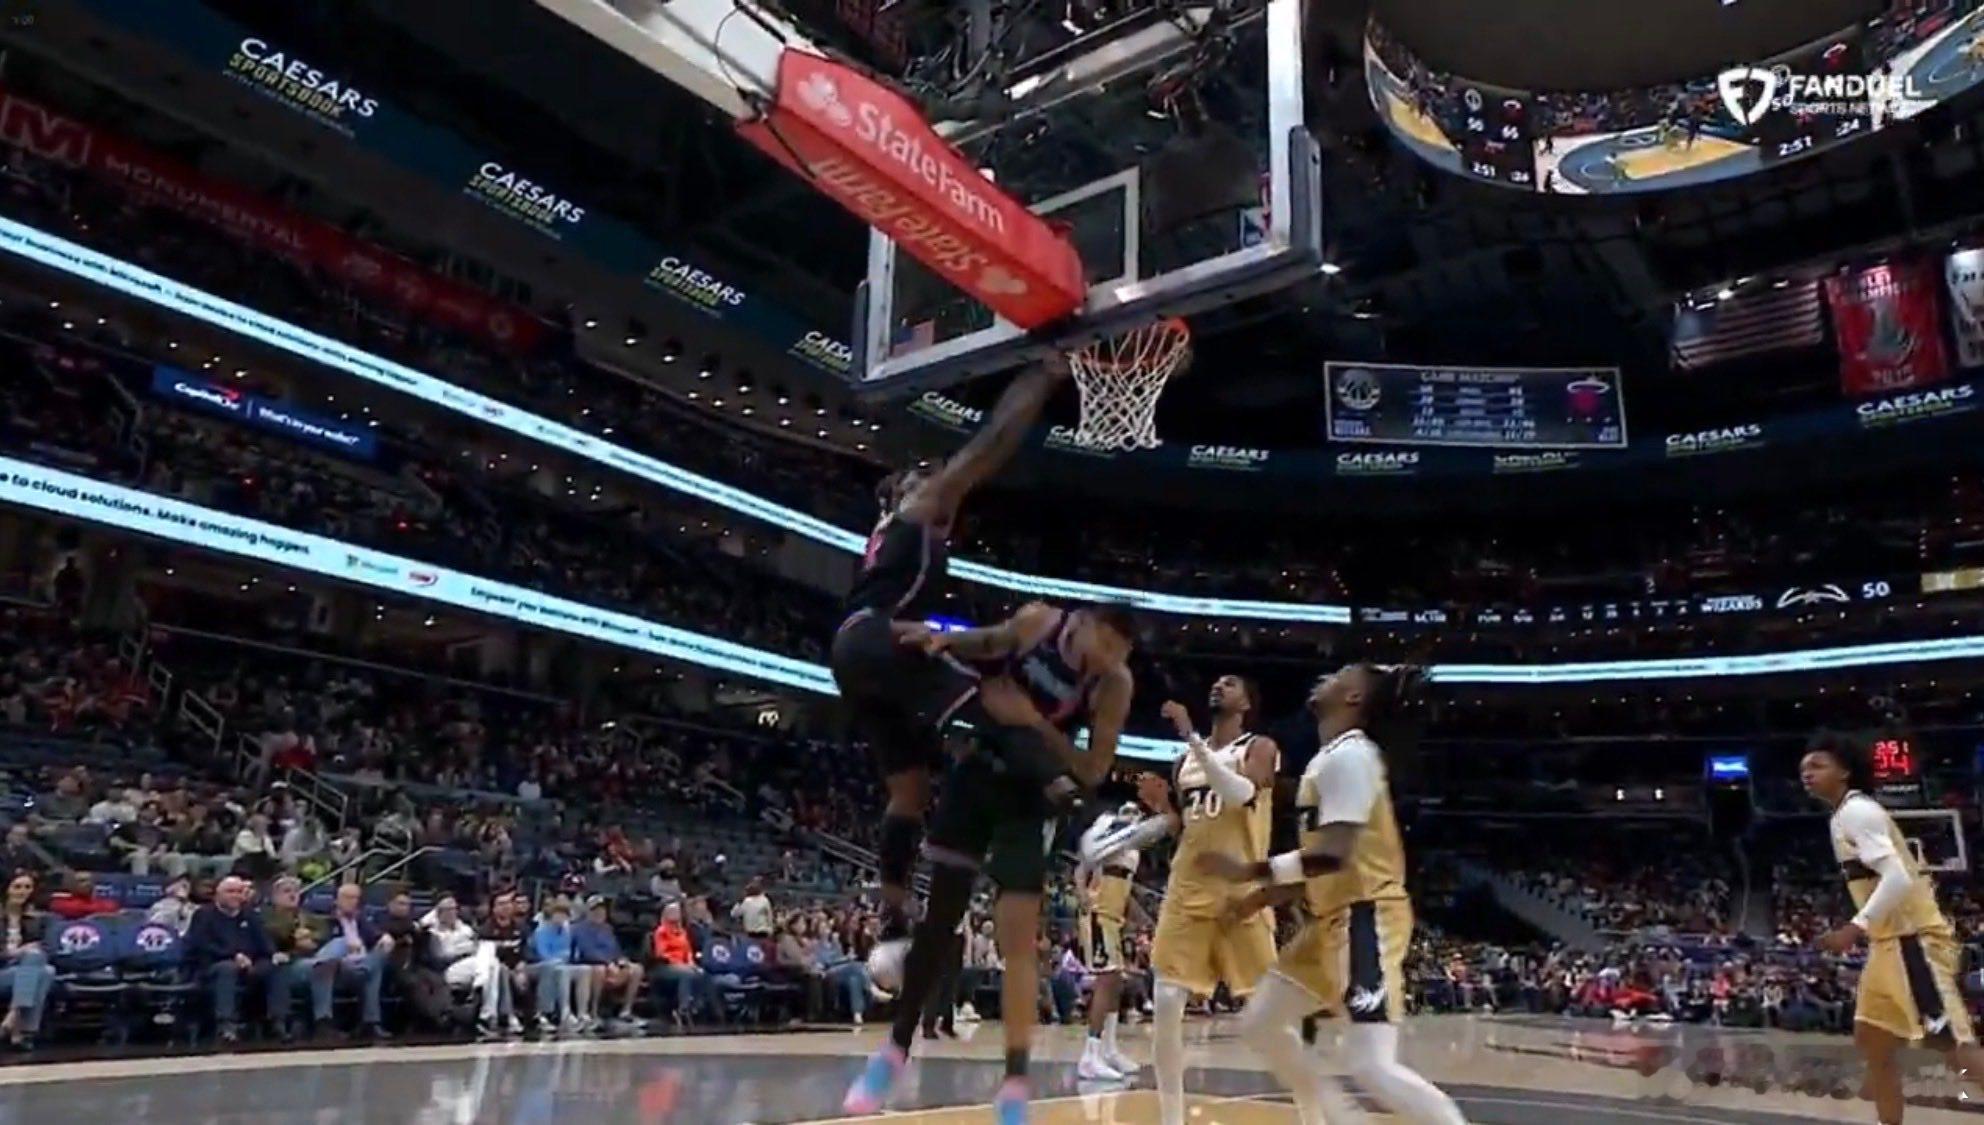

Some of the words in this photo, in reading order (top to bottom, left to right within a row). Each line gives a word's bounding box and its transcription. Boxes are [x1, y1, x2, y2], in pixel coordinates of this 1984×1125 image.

[228, 52, 346, 119] SPORTSBOOK
[239, 37, 379, 118] CAESARS
[479, 161, 586, 223] CAESARS
[855, 101, 1005, 234] StateFarm
[659, 256, 746, 306] CAESARS
[1856, 384, 1975, 415] CAESARS
[1191, 444, 1270, 462] CAESARS
[1336, 451, 1420, 465] CAESARS
[1666, 423, 1763, 447] CAESARS
[12, 473, 29, 487] to
[31, 479, 79, 499] cloud
[199, 521, 258, 545] amazing
[1862, 581, 1891, 599] 50
